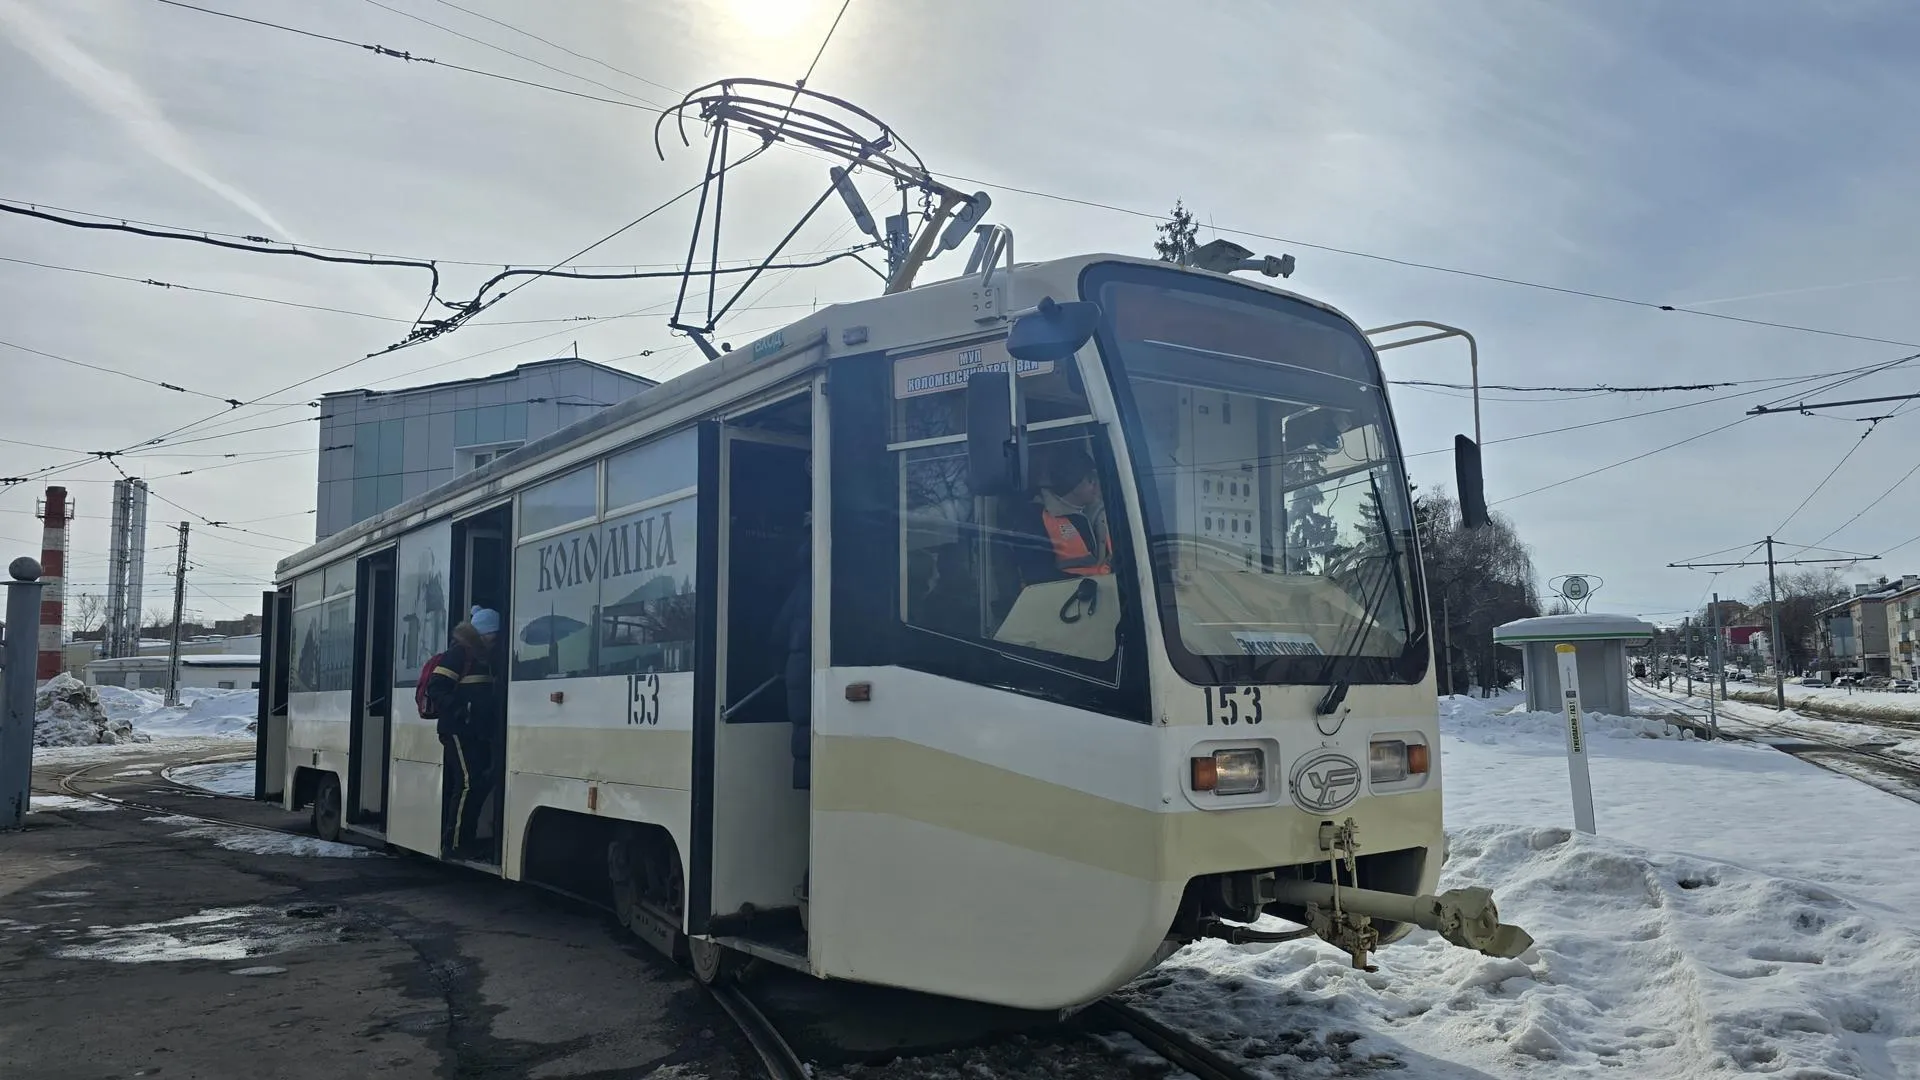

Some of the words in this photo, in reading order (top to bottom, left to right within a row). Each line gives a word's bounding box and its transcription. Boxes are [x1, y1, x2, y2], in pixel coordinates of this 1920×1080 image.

[959, 348, 982, 366] МУП
[538, 511, 677, 593] КОЛОМНА
[627, 674, 660, 726] 153
[1204, 686, 1263, 726] 153
